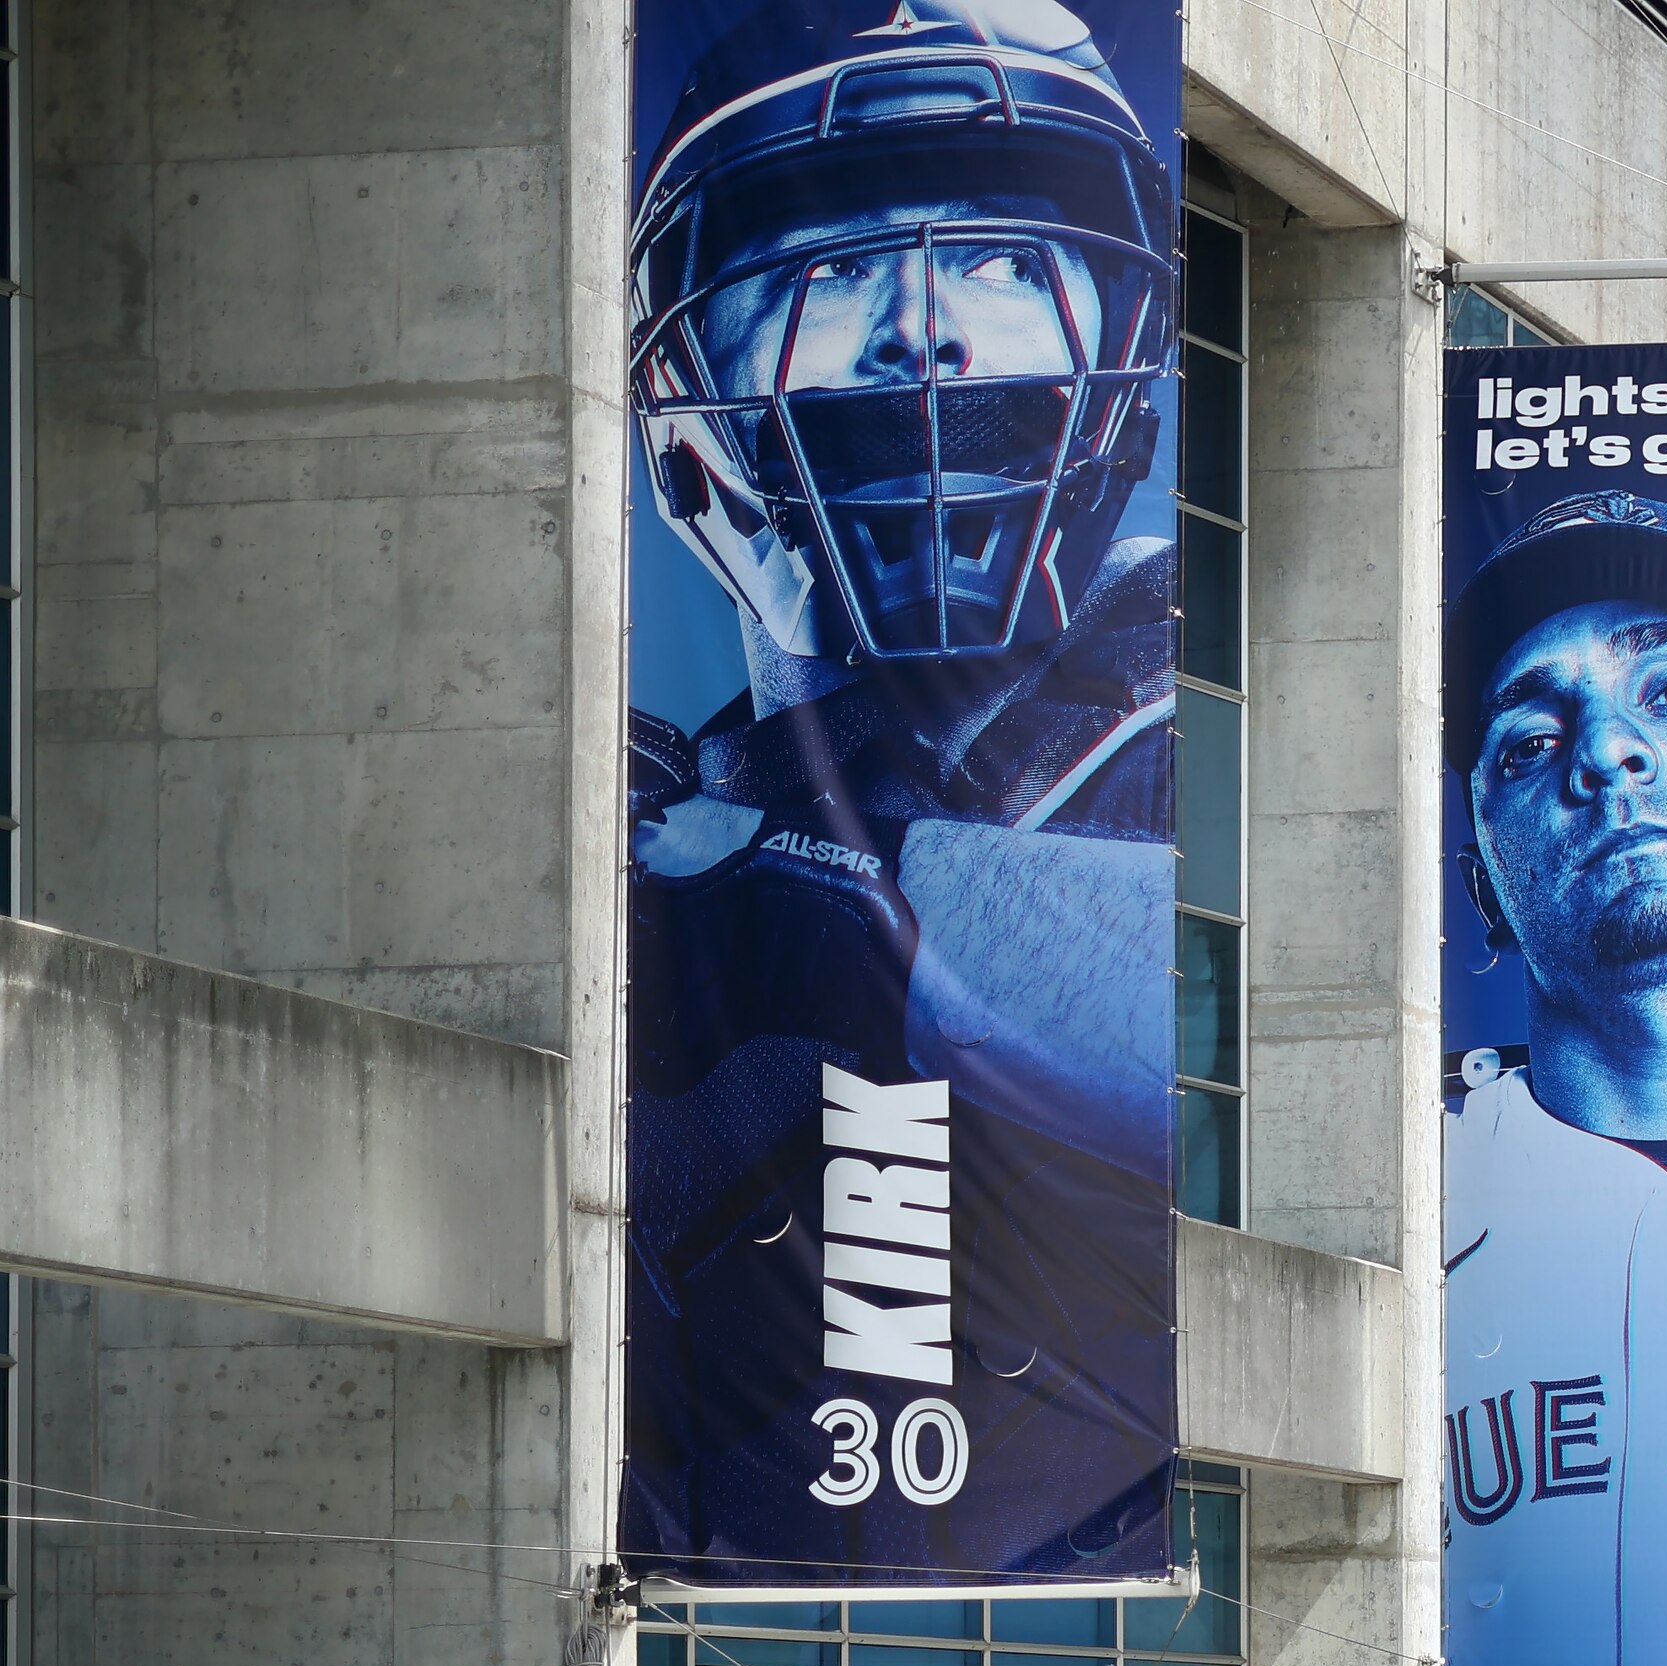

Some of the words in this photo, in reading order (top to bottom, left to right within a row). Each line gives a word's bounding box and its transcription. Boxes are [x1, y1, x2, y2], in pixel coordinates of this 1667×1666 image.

[1475, 426, 1632, 470] let’s
[760, 831, 881, 879] ALL-STAR
[822, 1062, 953, 1386] KIRK
[808, 1397, 969, 1506] 30
[1444, 1374, 1612, 1528] UE
